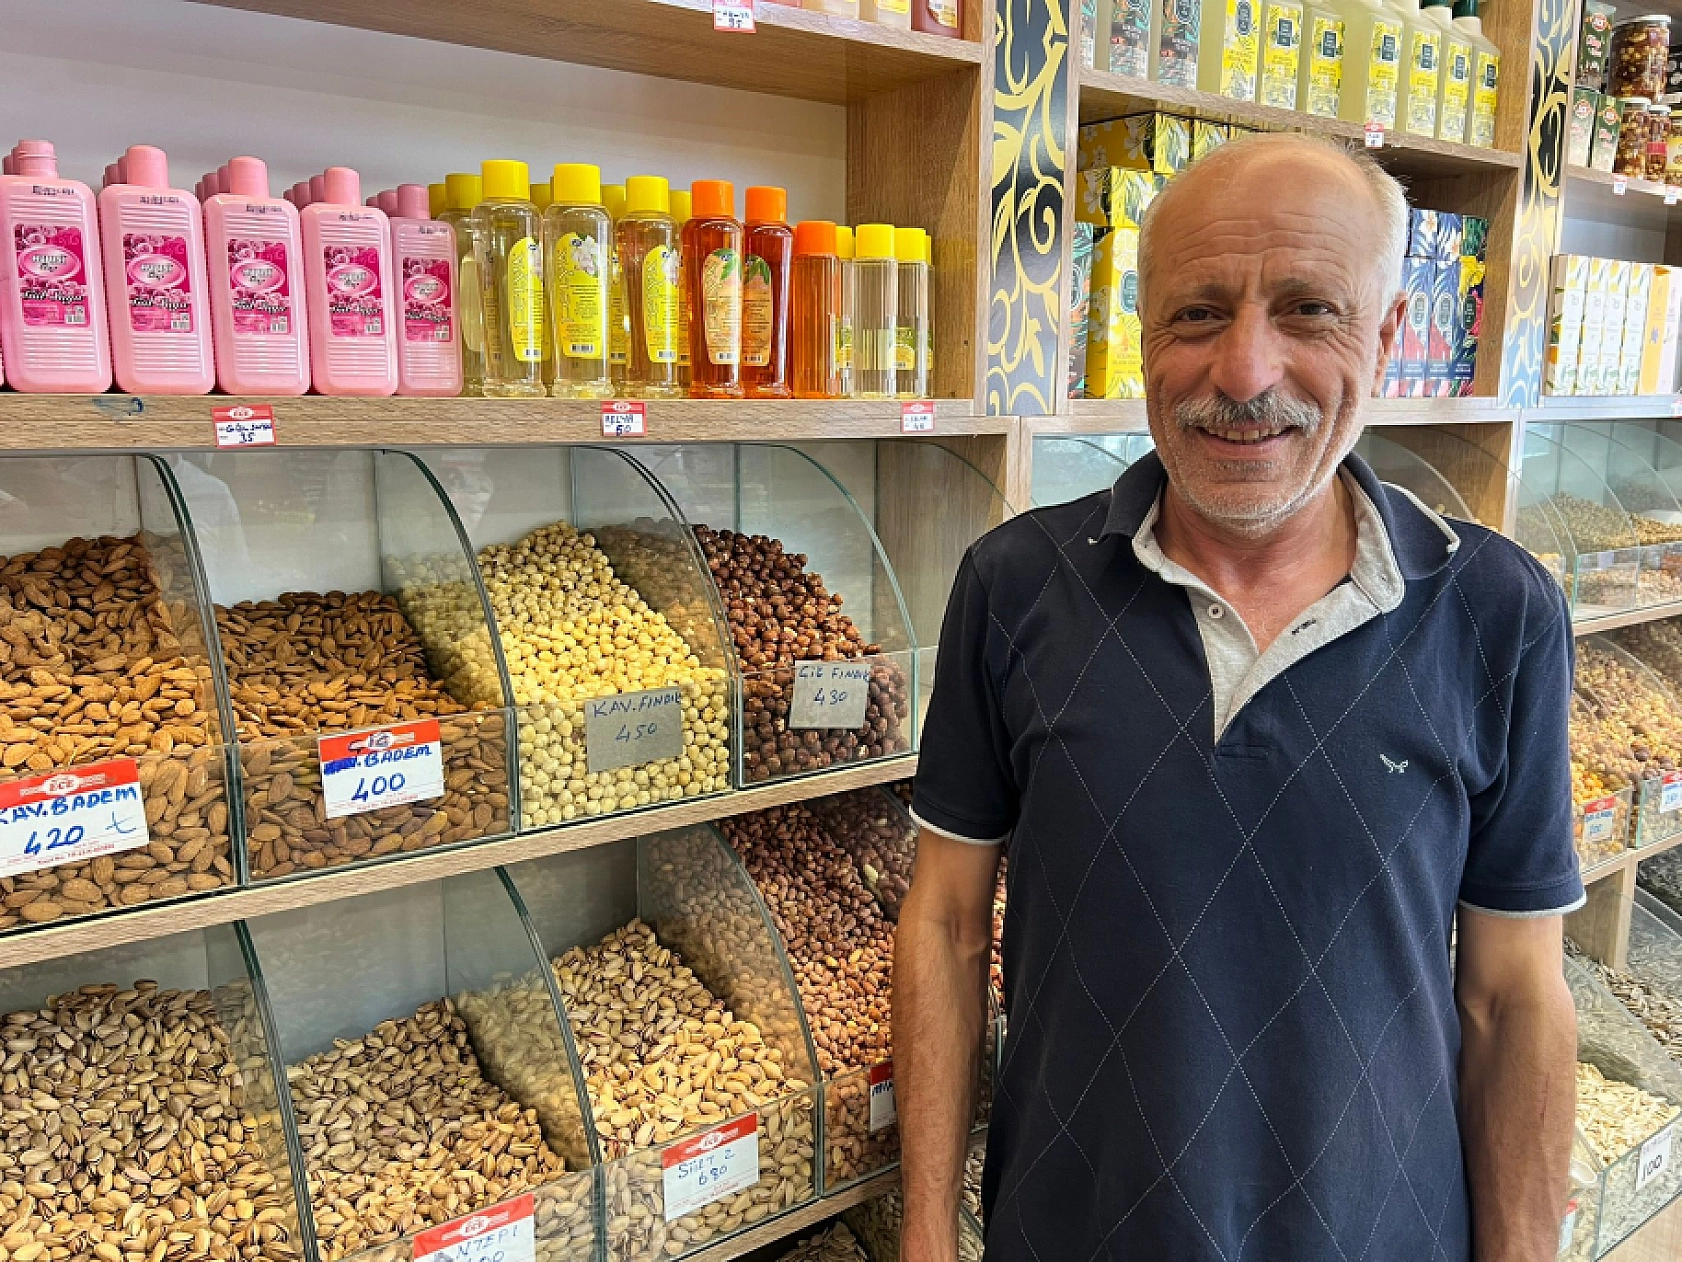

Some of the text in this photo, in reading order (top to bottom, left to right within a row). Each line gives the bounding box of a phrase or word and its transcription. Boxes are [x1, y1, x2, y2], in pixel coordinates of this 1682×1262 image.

[813, 687, 849, 706] 430
[615, 722, 658, 742] 450
[351, 772, 406, 803] 400
[23, 825, 84, 855] 420
